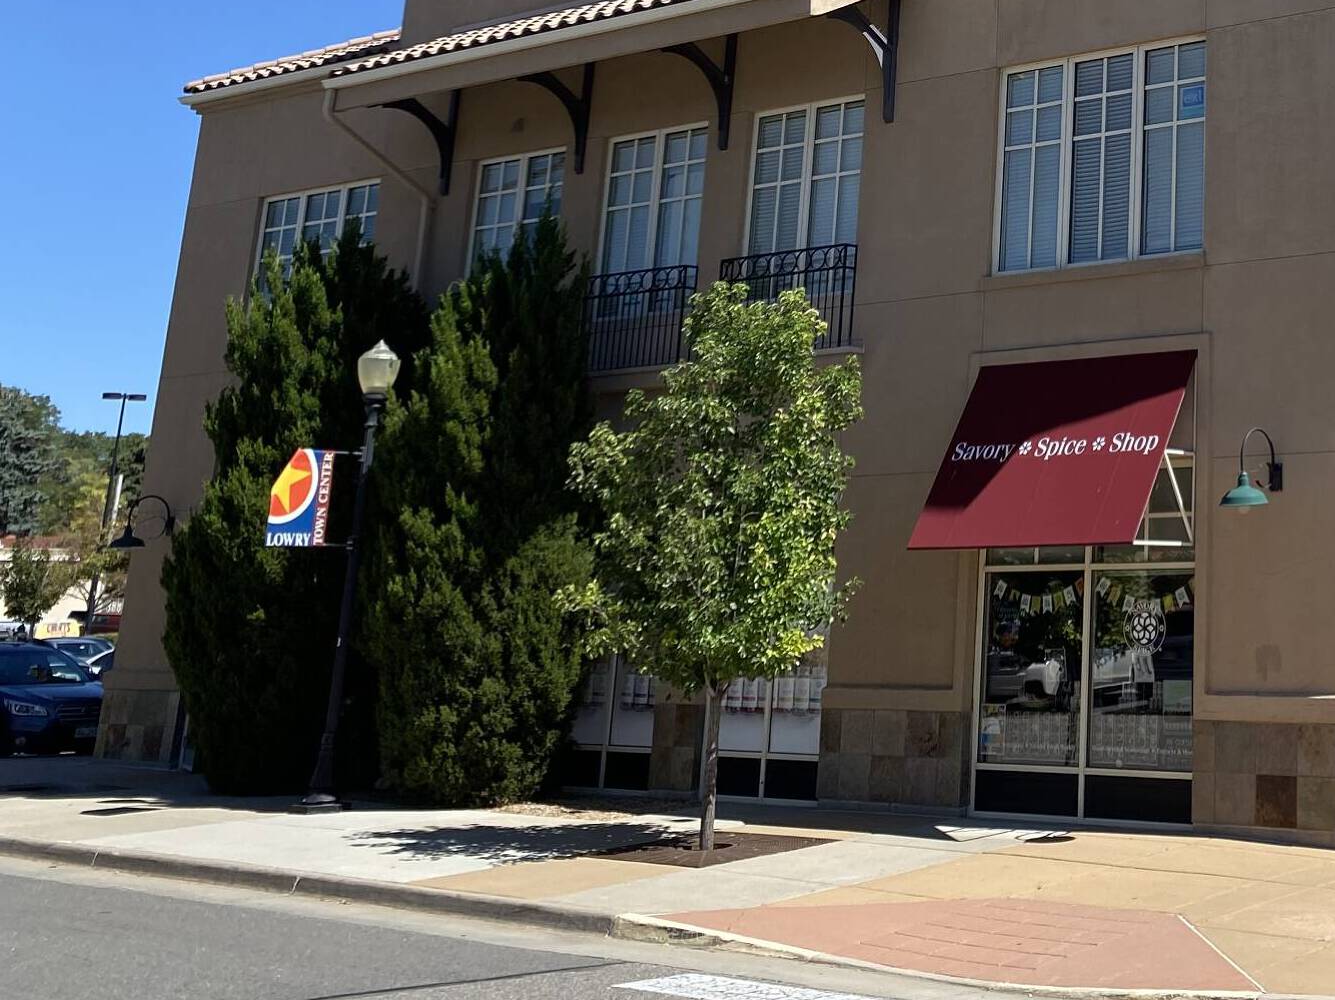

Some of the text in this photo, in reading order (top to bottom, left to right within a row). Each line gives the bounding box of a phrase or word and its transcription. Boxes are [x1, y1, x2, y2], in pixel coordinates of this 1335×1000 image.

[951, 431, 1159, 462] Savory Spice Shop
[312, 452, 335, 546] TOWN CENTER
[265, 532, 311, 547] LOWRY
